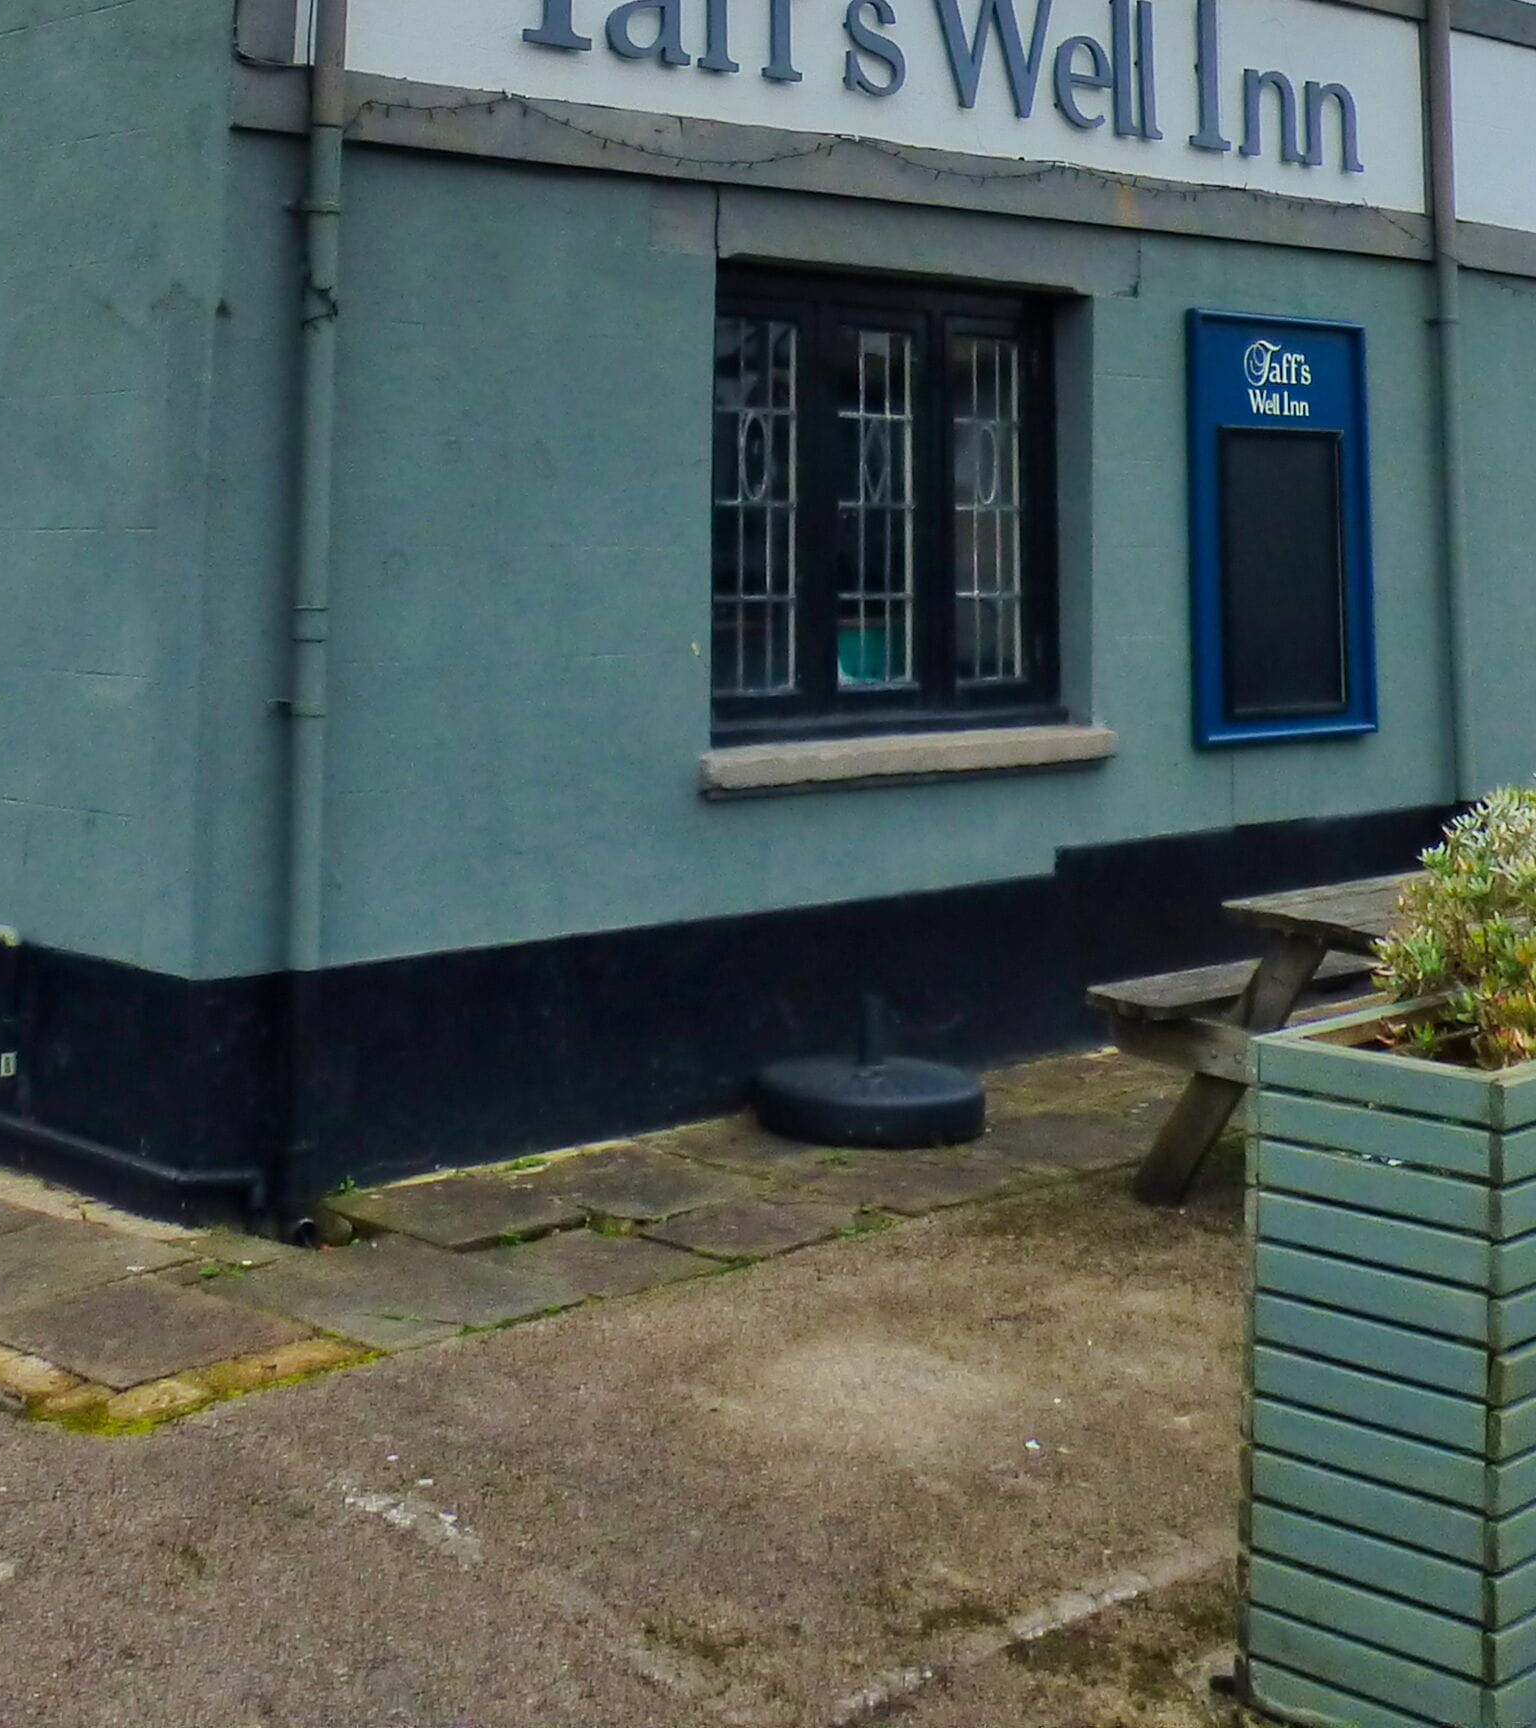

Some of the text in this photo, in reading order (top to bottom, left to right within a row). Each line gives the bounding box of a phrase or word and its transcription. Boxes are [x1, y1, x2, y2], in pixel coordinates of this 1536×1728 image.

[1243, 339, 1312, 386] Taff's
[1248, 388, 1310, 417] Well Inn
